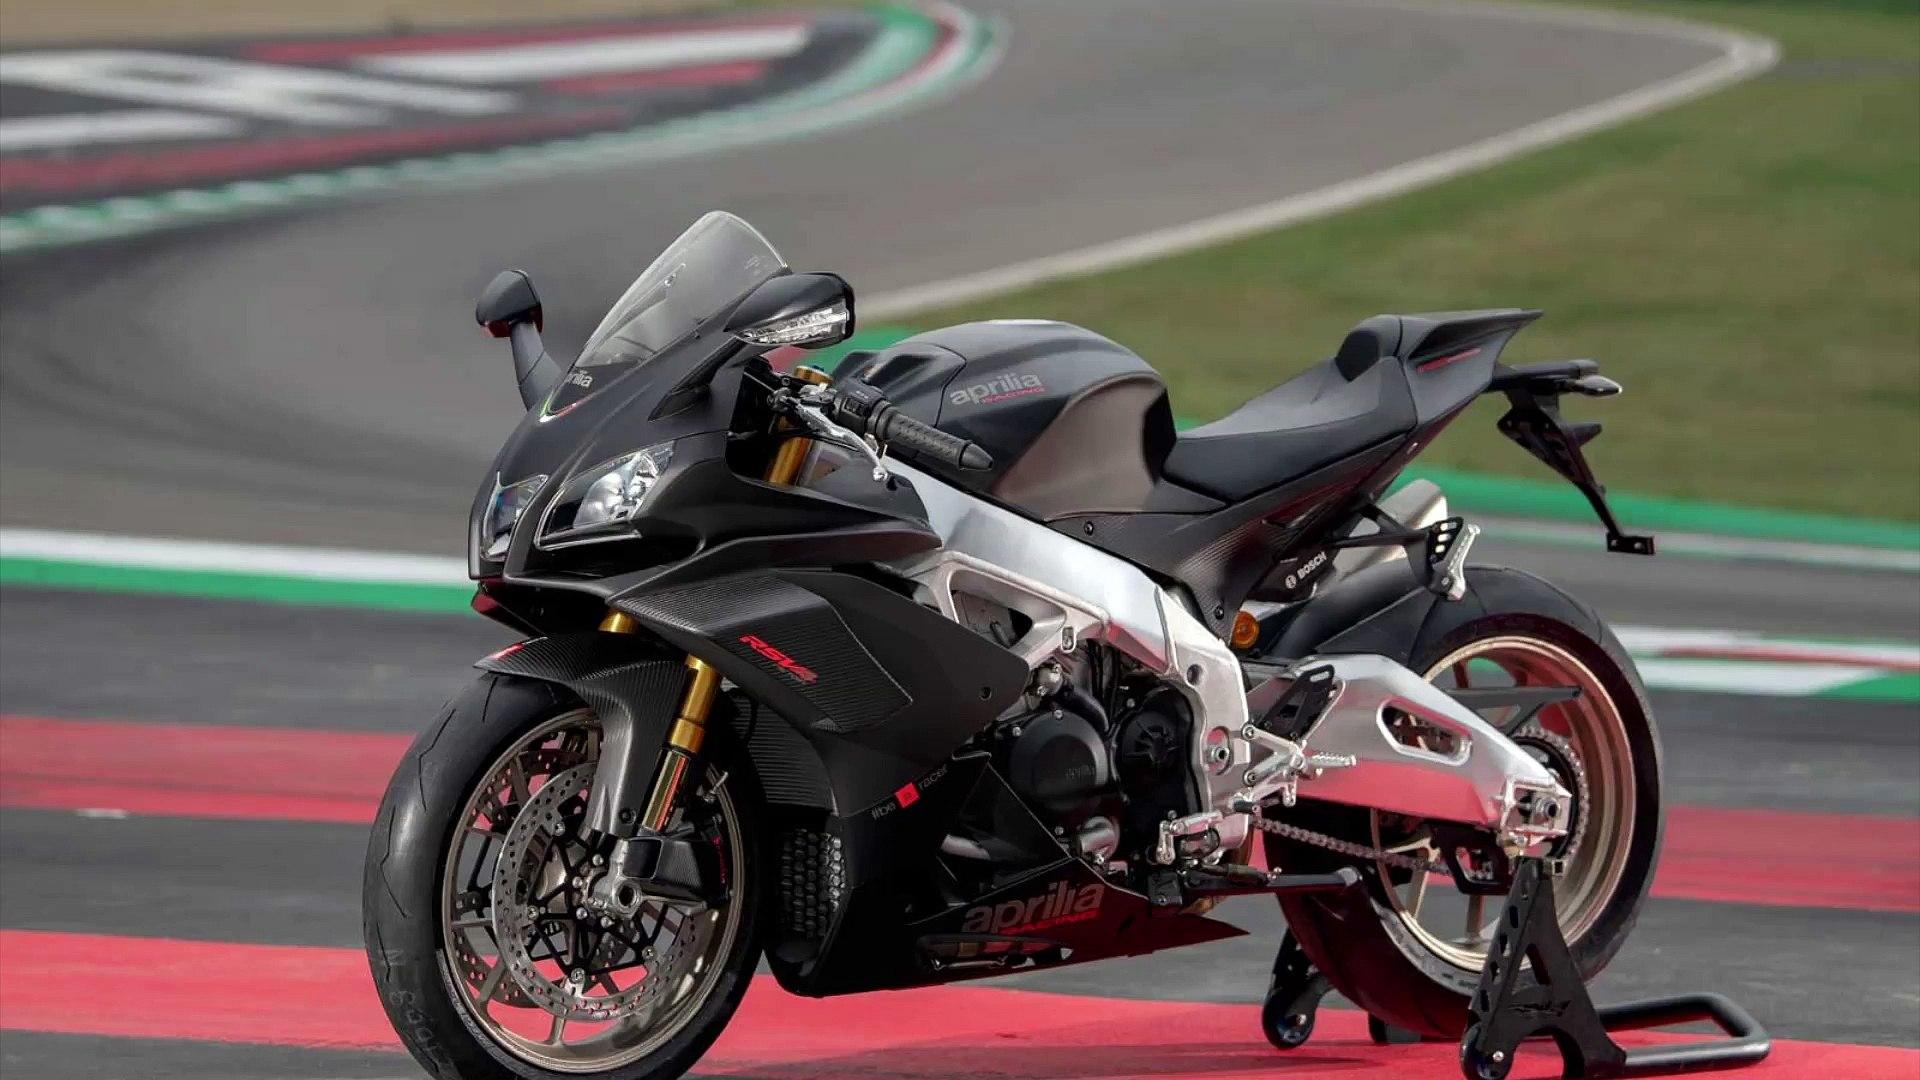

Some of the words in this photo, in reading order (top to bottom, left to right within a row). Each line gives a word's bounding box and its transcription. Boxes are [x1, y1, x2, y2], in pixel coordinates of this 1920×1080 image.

[567, 370, 593, 388] rilia
[950, 372, 1043, 405] aprilia
[1297, 551, 1327, 580] BOSCH
[961, 880, 1105, 934] aprilia
